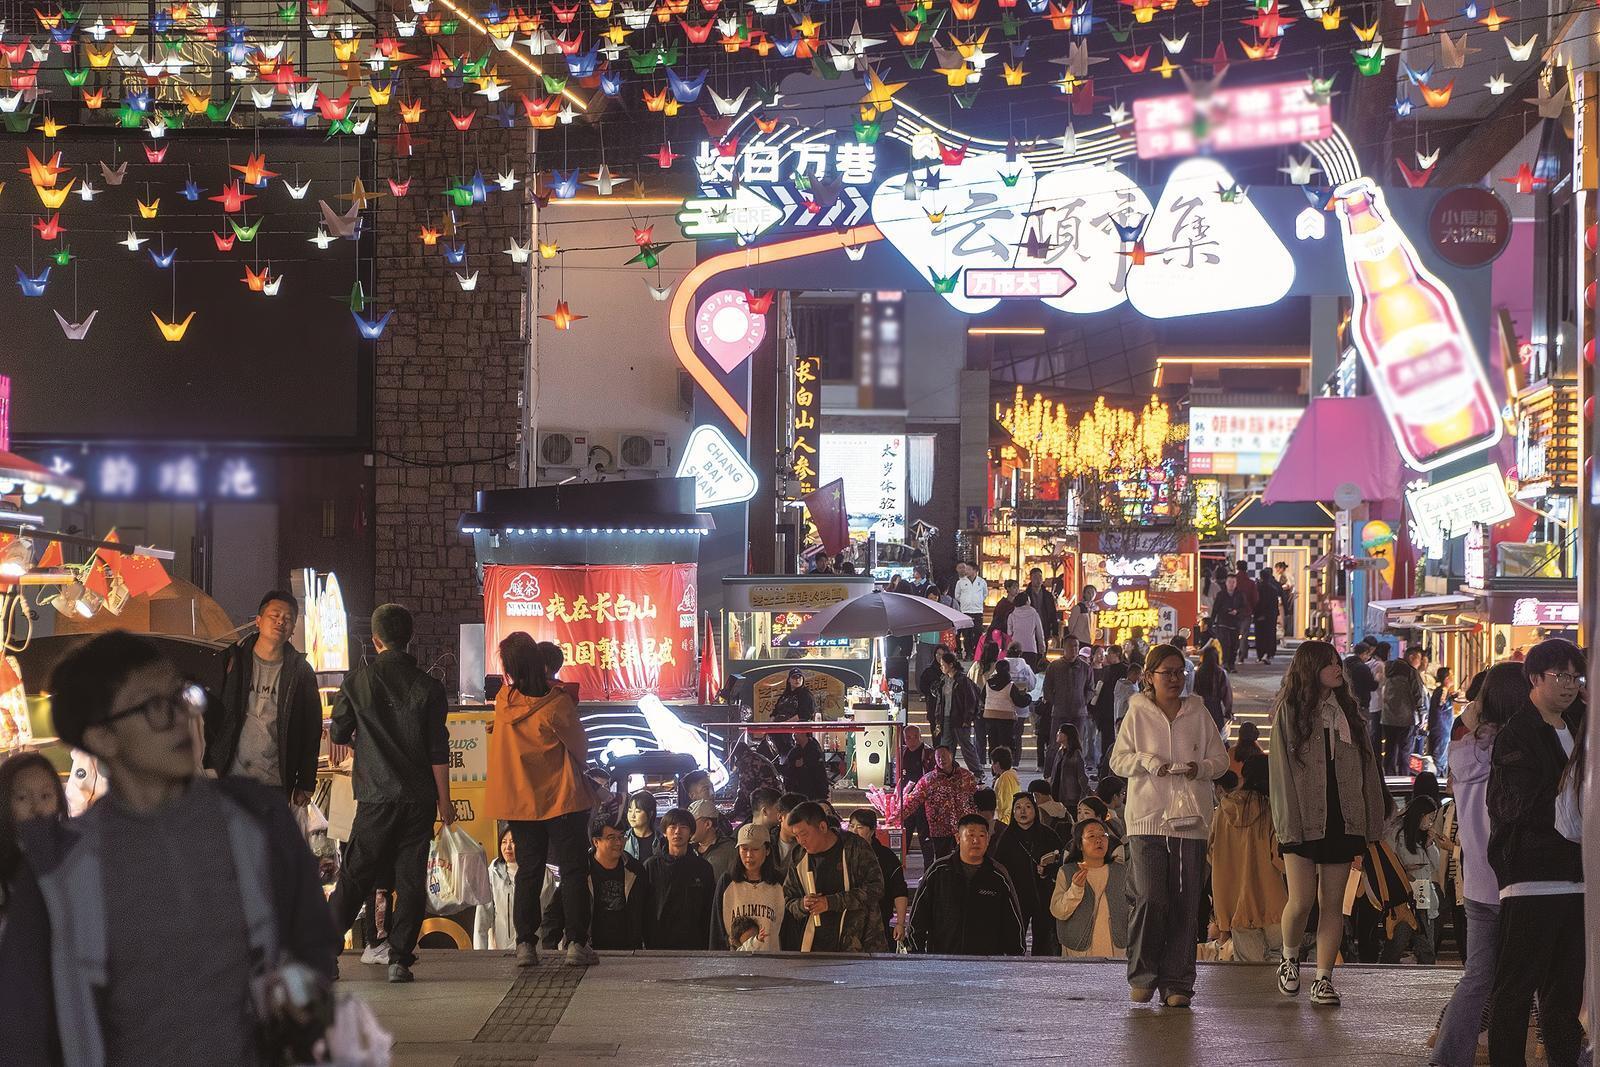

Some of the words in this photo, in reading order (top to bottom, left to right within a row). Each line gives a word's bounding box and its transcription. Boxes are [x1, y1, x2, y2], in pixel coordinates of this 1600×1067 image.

[693, 141, 877, 184] 长白万巷
[701, 294, 745, 345] YUNDING
[703, 461, 723, 483] BAI
[707, 442, 743, 483] CHANG
[687, 465, 716, 498] SHAN
[546, 591, 656, 624] 我在长白山
[772, 622, 797, 635] 芝士
